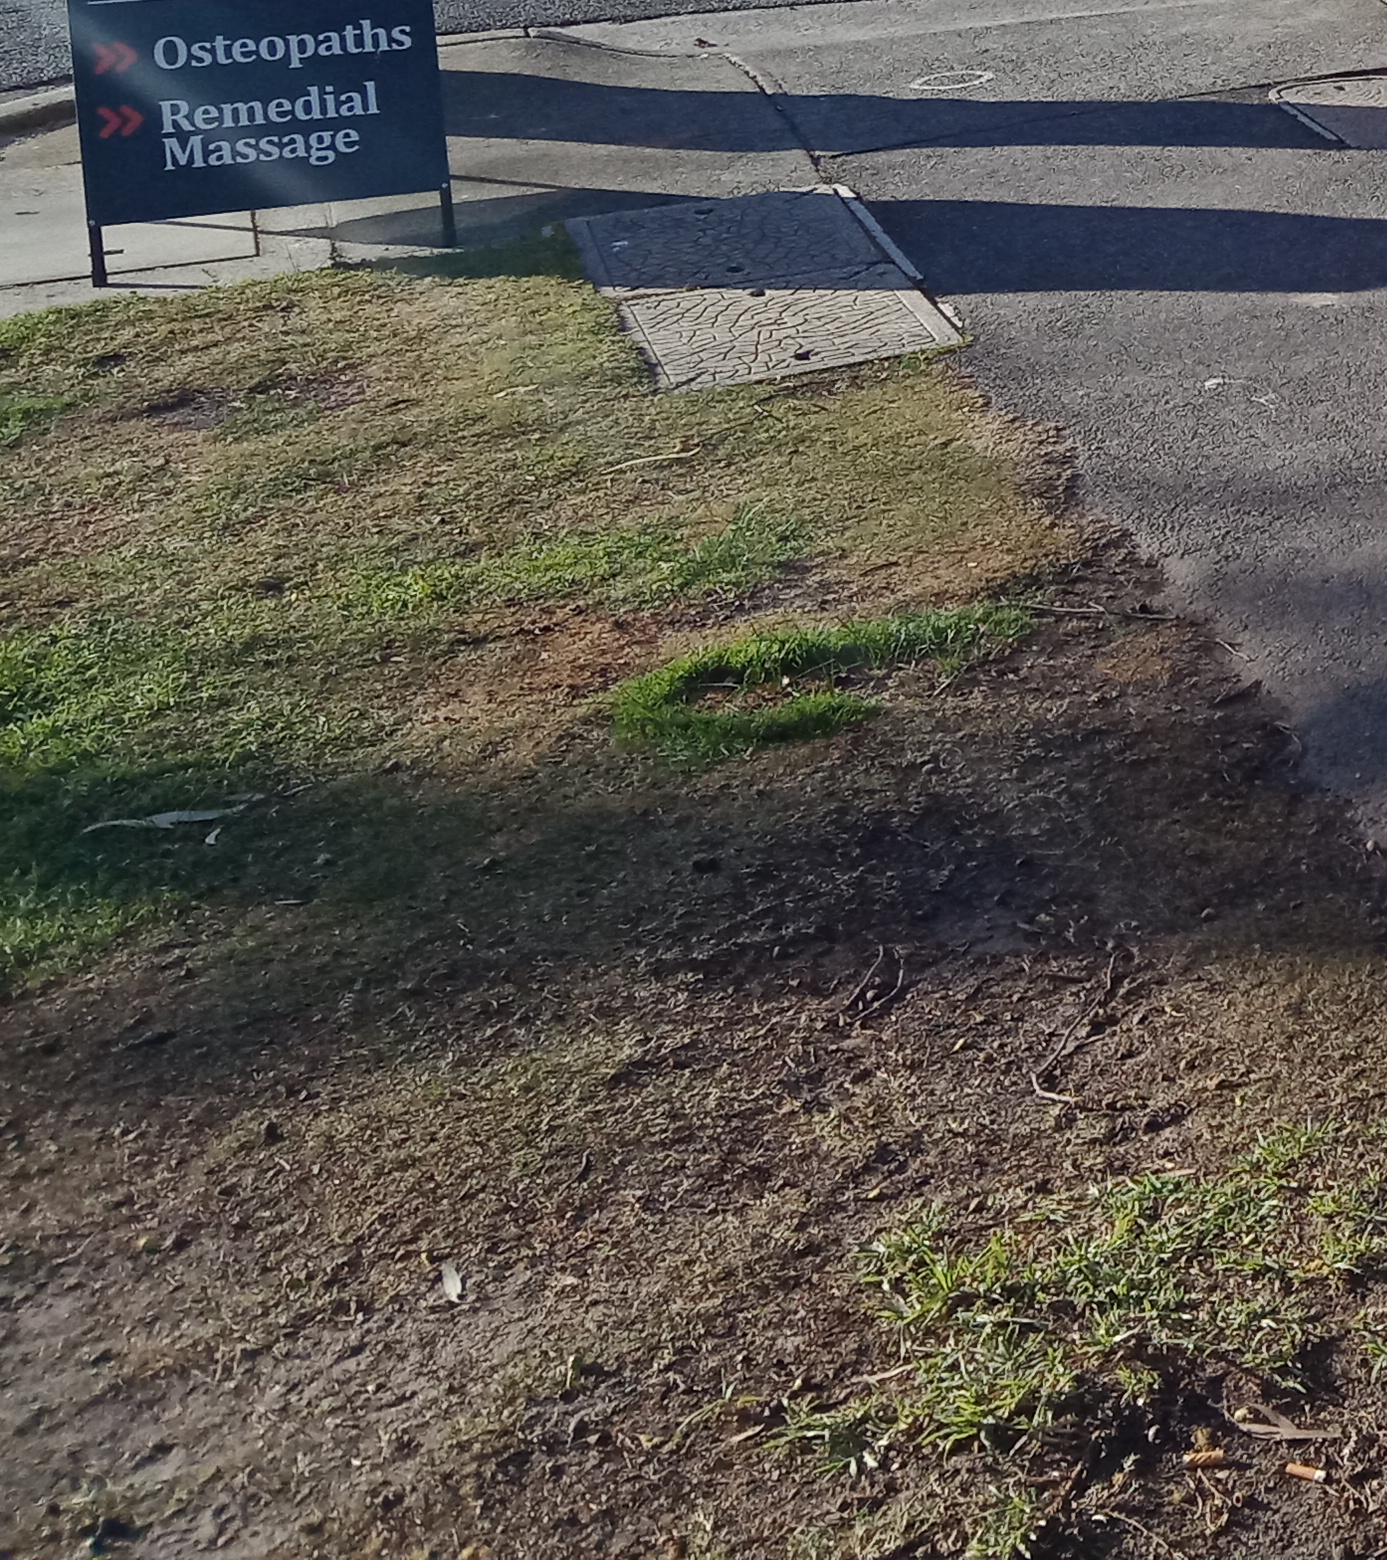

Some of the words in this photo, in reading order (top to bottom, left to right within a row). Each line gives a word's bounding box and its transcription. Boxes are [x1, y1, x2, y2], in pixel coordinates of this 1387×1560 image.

[153, 19, 413, 70] Osteopaths
[158, 81, 381, 134] Remedial
[163, 125, 361, 172] Massage
